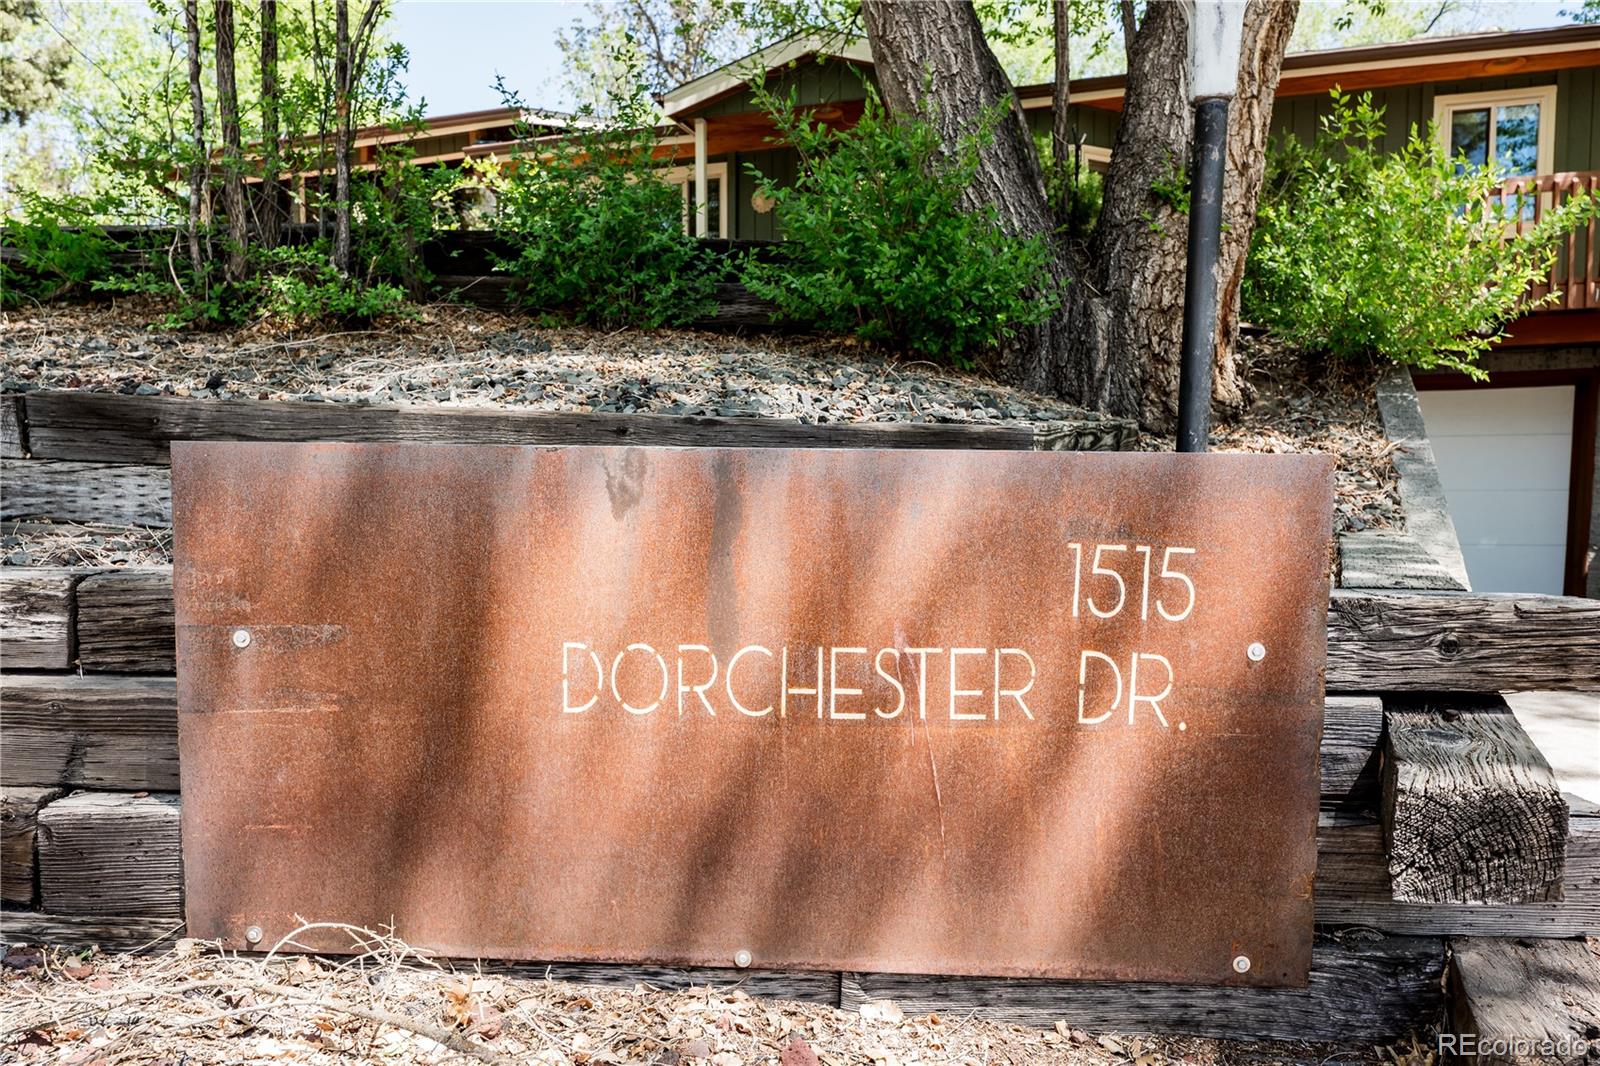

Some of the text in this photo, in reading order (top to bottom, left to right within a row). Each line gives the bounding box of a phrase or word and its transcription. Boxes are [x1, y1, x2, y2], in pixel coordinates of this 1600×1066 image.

[1067, 543, 1196, 621] 1515
[562, 642, 1187, 731] DORCHESTER DR.
